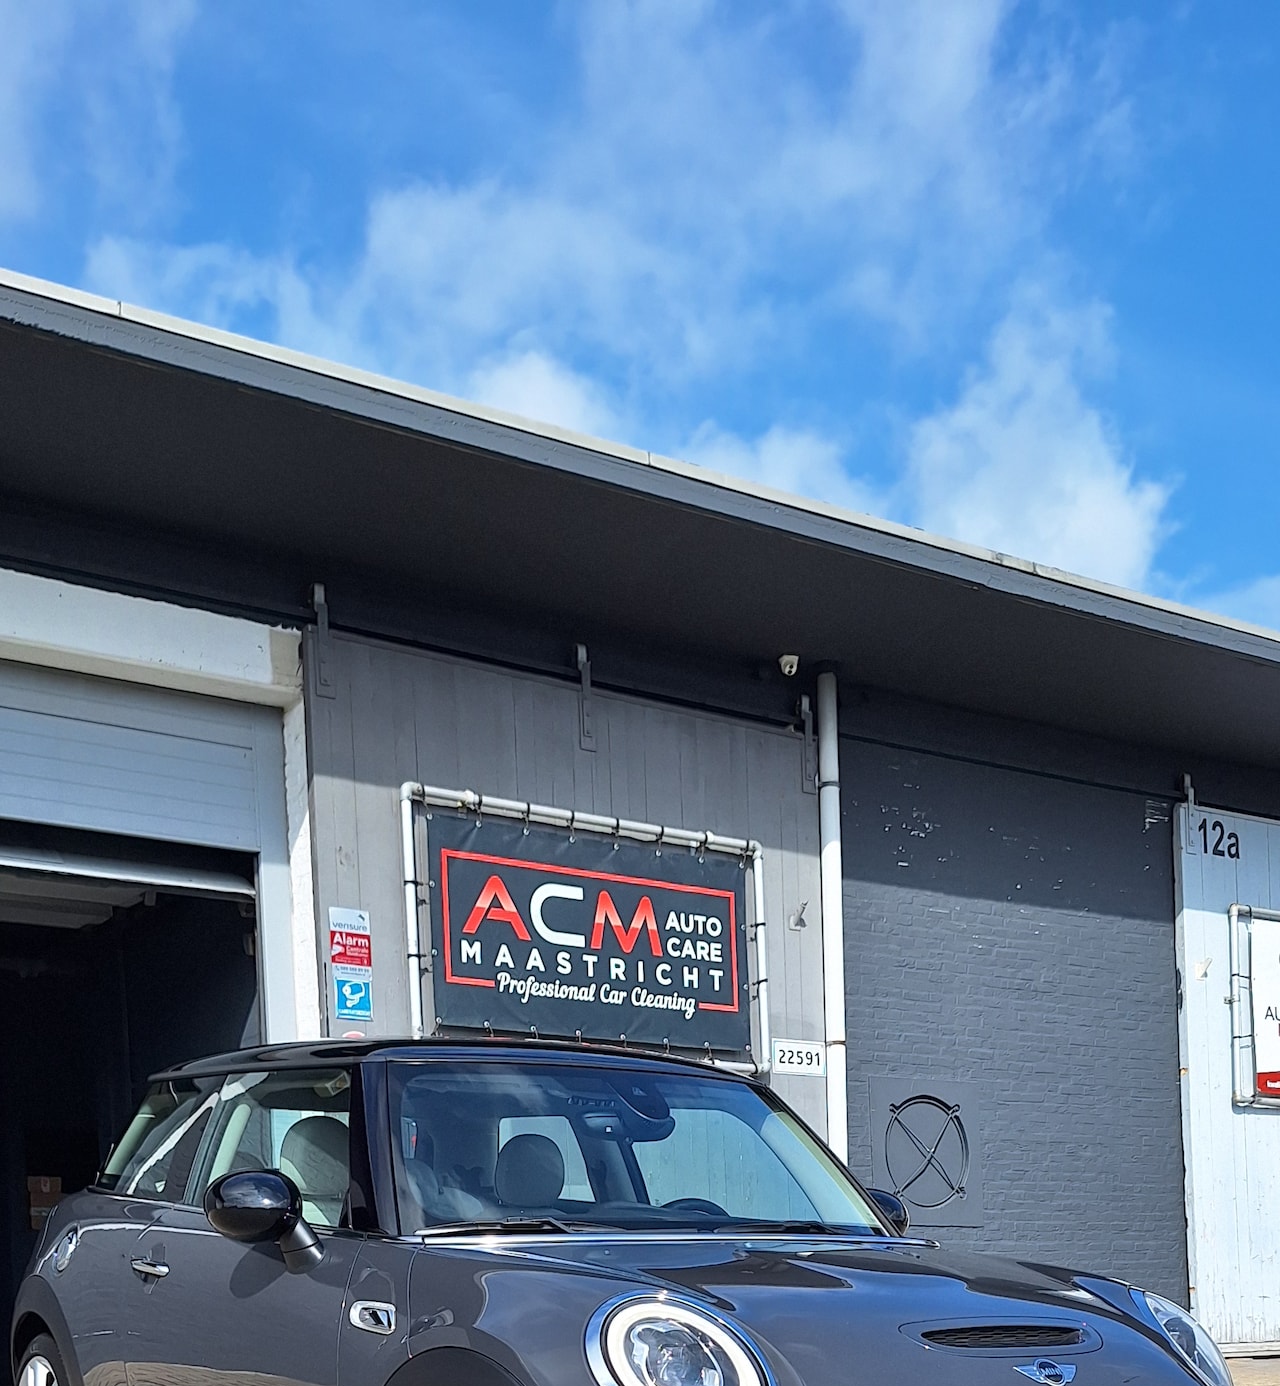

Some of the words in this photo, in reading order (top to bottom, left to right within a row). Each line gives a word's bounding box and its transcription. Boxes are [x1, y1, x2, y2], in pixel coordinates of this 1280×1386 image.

[1198, 818, 1240, 859] 12a
[332, 921, 368, 932] verisure
[462, 875, 663, 957] ACM
[665, 911, 722, 937] AUTO
[333, 932, 369, 947] Alarm
[666, 938, 723, 962] CARE
[460, 939, 724, 991] MAASTRICHT
[496, 972, 596, 1004] Professional
[599, 983, 627, 1005] Car
[631, 987, 696, 1020] Cleaning
[779, 1049, 820, 1066] 22591
